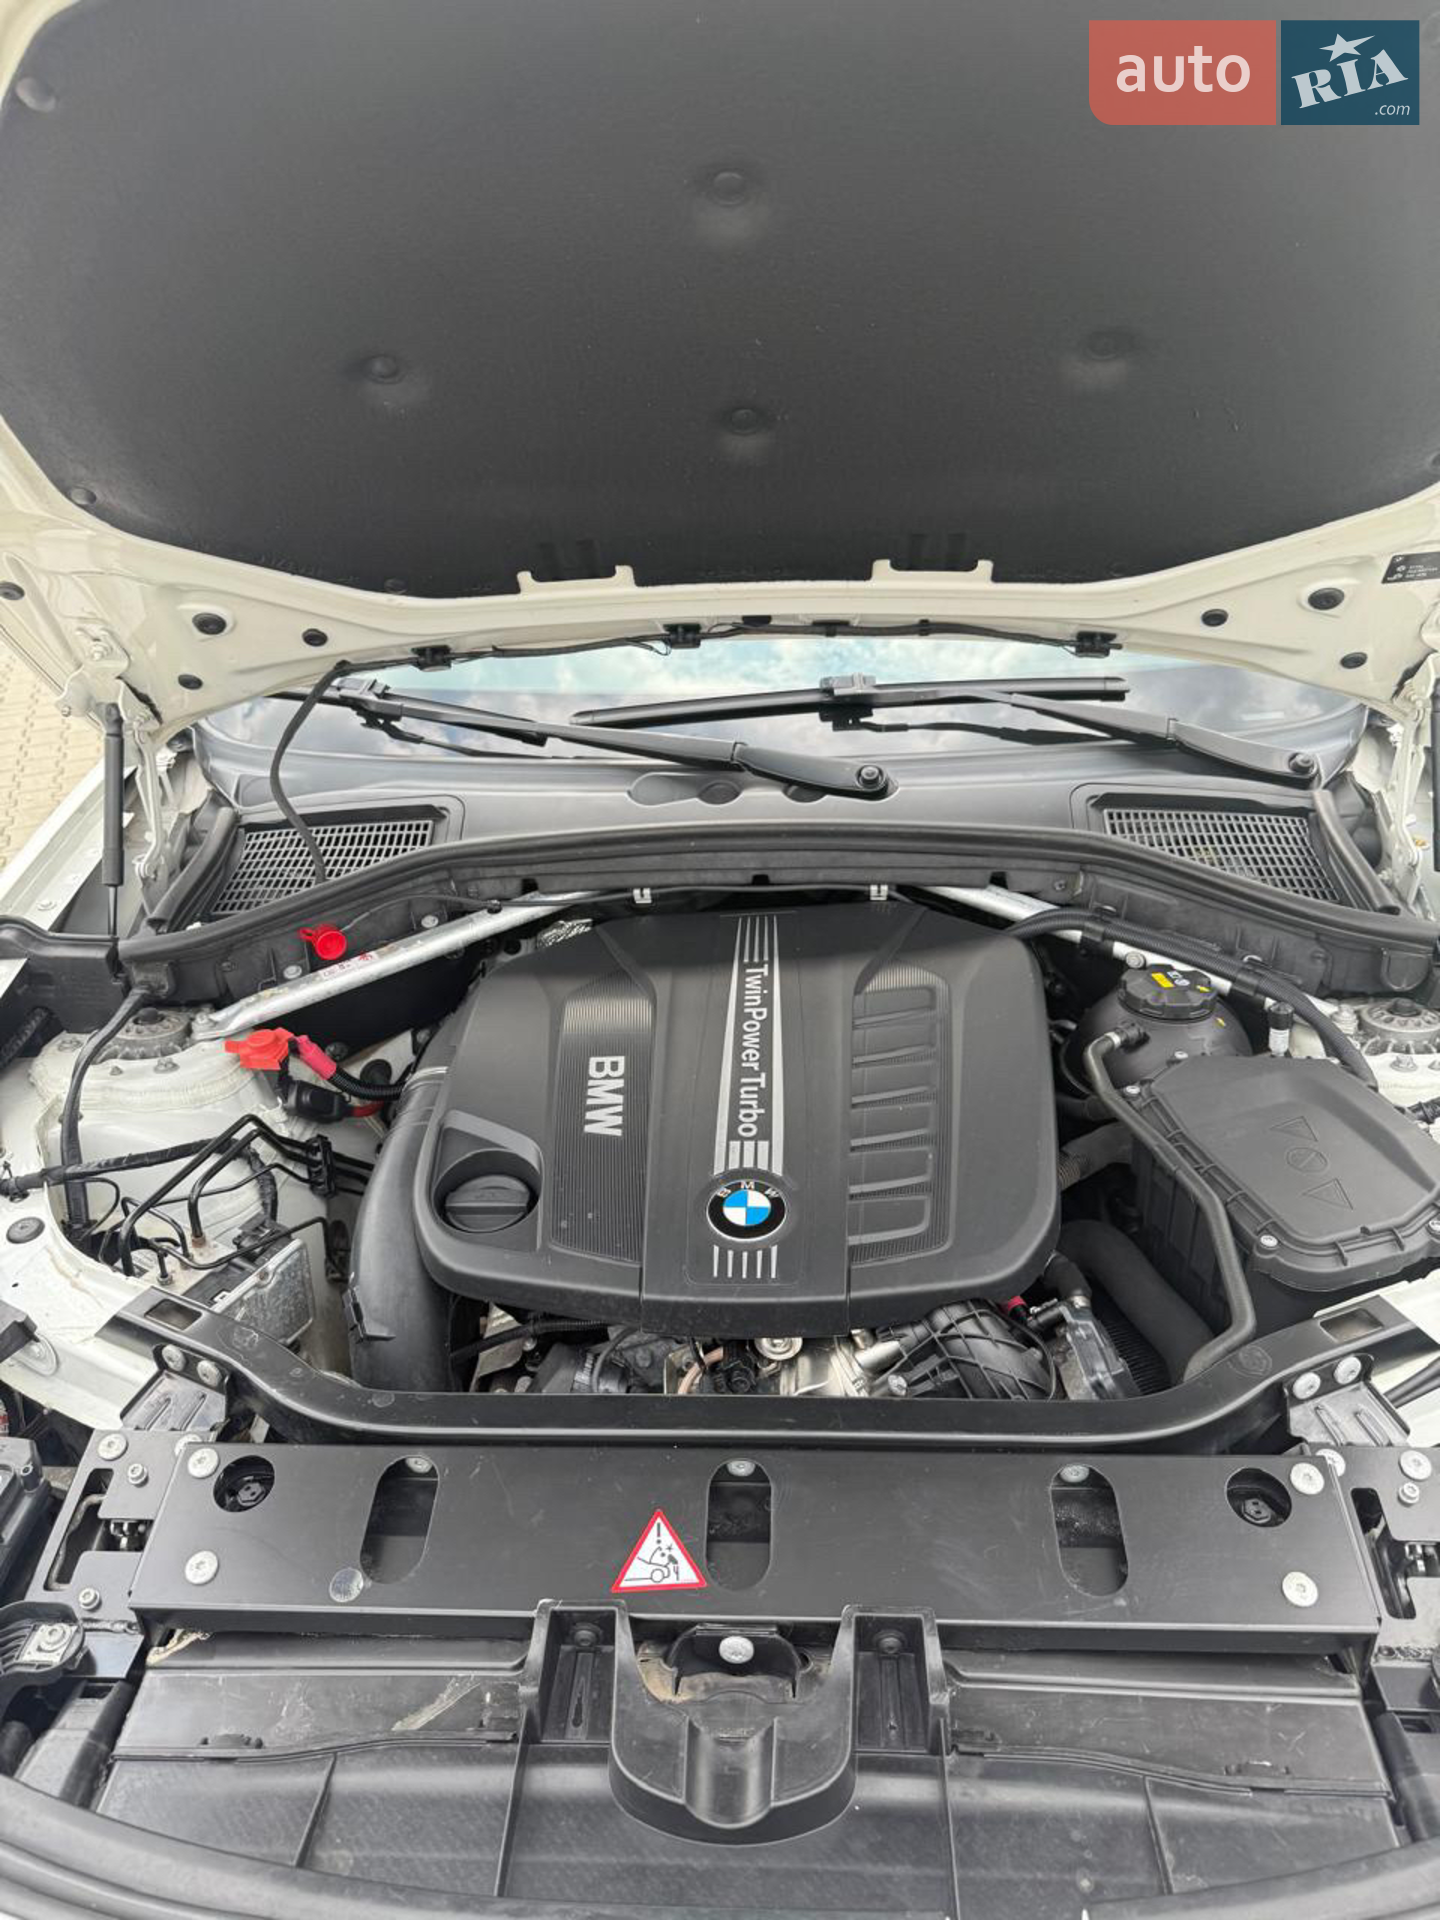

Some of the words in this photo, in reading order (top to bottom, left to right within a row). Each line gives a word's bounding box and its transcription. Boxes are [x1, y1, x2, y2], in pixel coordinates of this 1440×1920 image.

[741, 964, 769, 1071] TwinPower
[584, 1055, 625, 1137] BMW
[737, 1072, 767, 1138] Turbo
[717, 1180, 781, 1198] BMW
